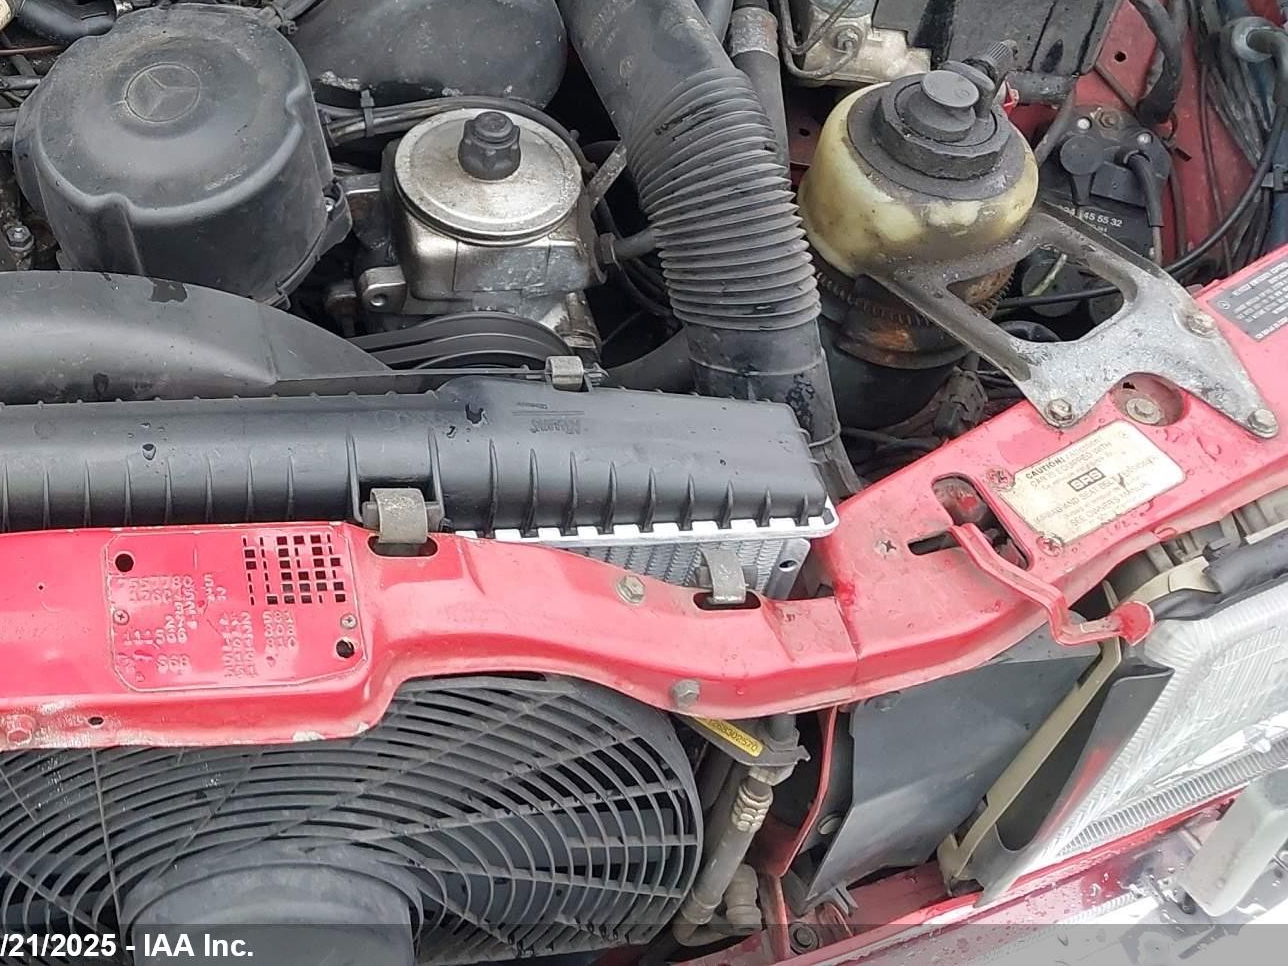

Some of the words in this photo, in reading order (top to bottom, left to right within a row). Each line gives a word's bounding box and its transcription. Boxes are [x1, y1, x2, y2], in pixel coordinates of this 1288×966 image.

[1110, 218, 1124, 228] 32
[1093, 440, 1113, 455] WITH
[1025, 456, 1065, 480] CAUTION!
[1069, 469, 1104, 490] SRS
